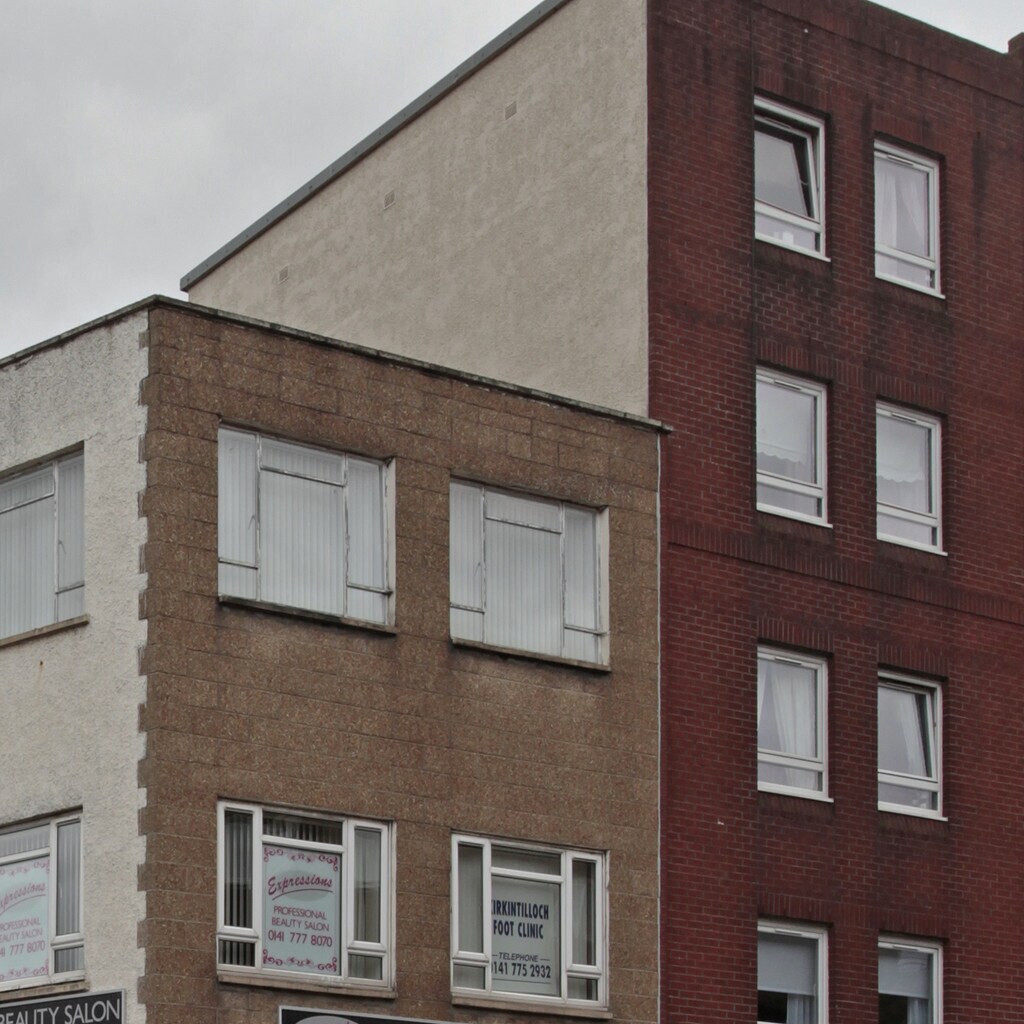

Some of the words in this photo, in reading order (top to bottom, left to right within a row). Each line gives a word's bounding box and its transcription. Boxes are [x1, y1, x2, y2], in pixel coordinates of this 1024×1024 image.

[268, 874, 333, 896] Expressions
[274, 905, 327, 920] PROFESSIONAL
[272, 917, 302, 929] BEAUTY
[304, 920, 329, 932] SALON
[493, 919, 514, 936] FOOT
[518, 922, 543, 940] CLINIC
[21, 927, 43, 939] SALON
[268, 929, 284, 942] 0141
[290, 932, 308, 944] 777
[310, 934, 332, 948] 8070
[10, 943, 24, 956] 777
[27, 940, 46, 953] 8070
[499, 952, 538, 962] TELEPHONE
[512, 963, 527, 977] 775
[530, 964, 551, 978] 2932
